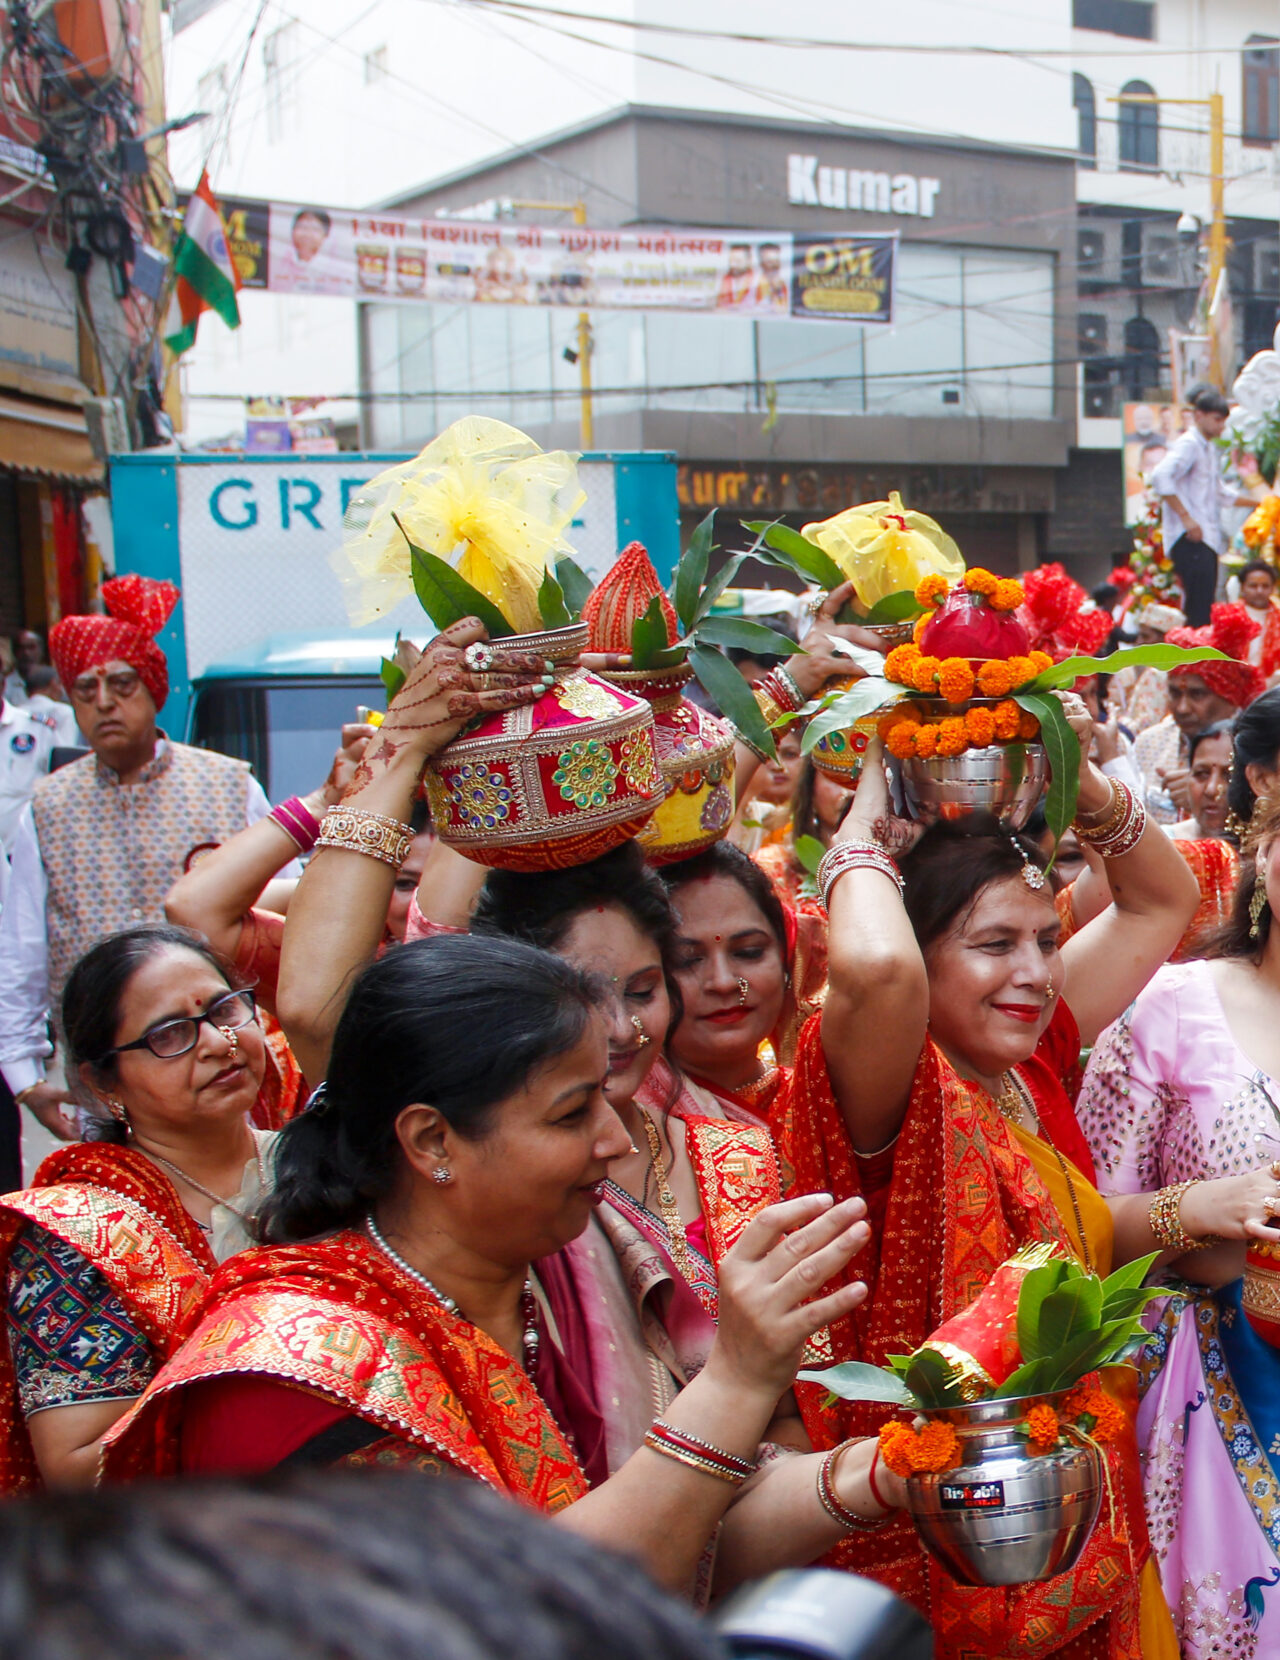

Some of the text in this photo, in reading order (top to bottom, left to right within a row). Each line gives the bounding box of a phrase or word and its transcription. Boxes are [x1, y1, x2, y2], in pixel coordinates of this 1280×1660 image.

[787, 154, 940, 218] Kumar
[560, 228, 622, 255] गणेश
[637, 231, 725, 257] महोत्सव
[806, 243, 874, 278] OM
